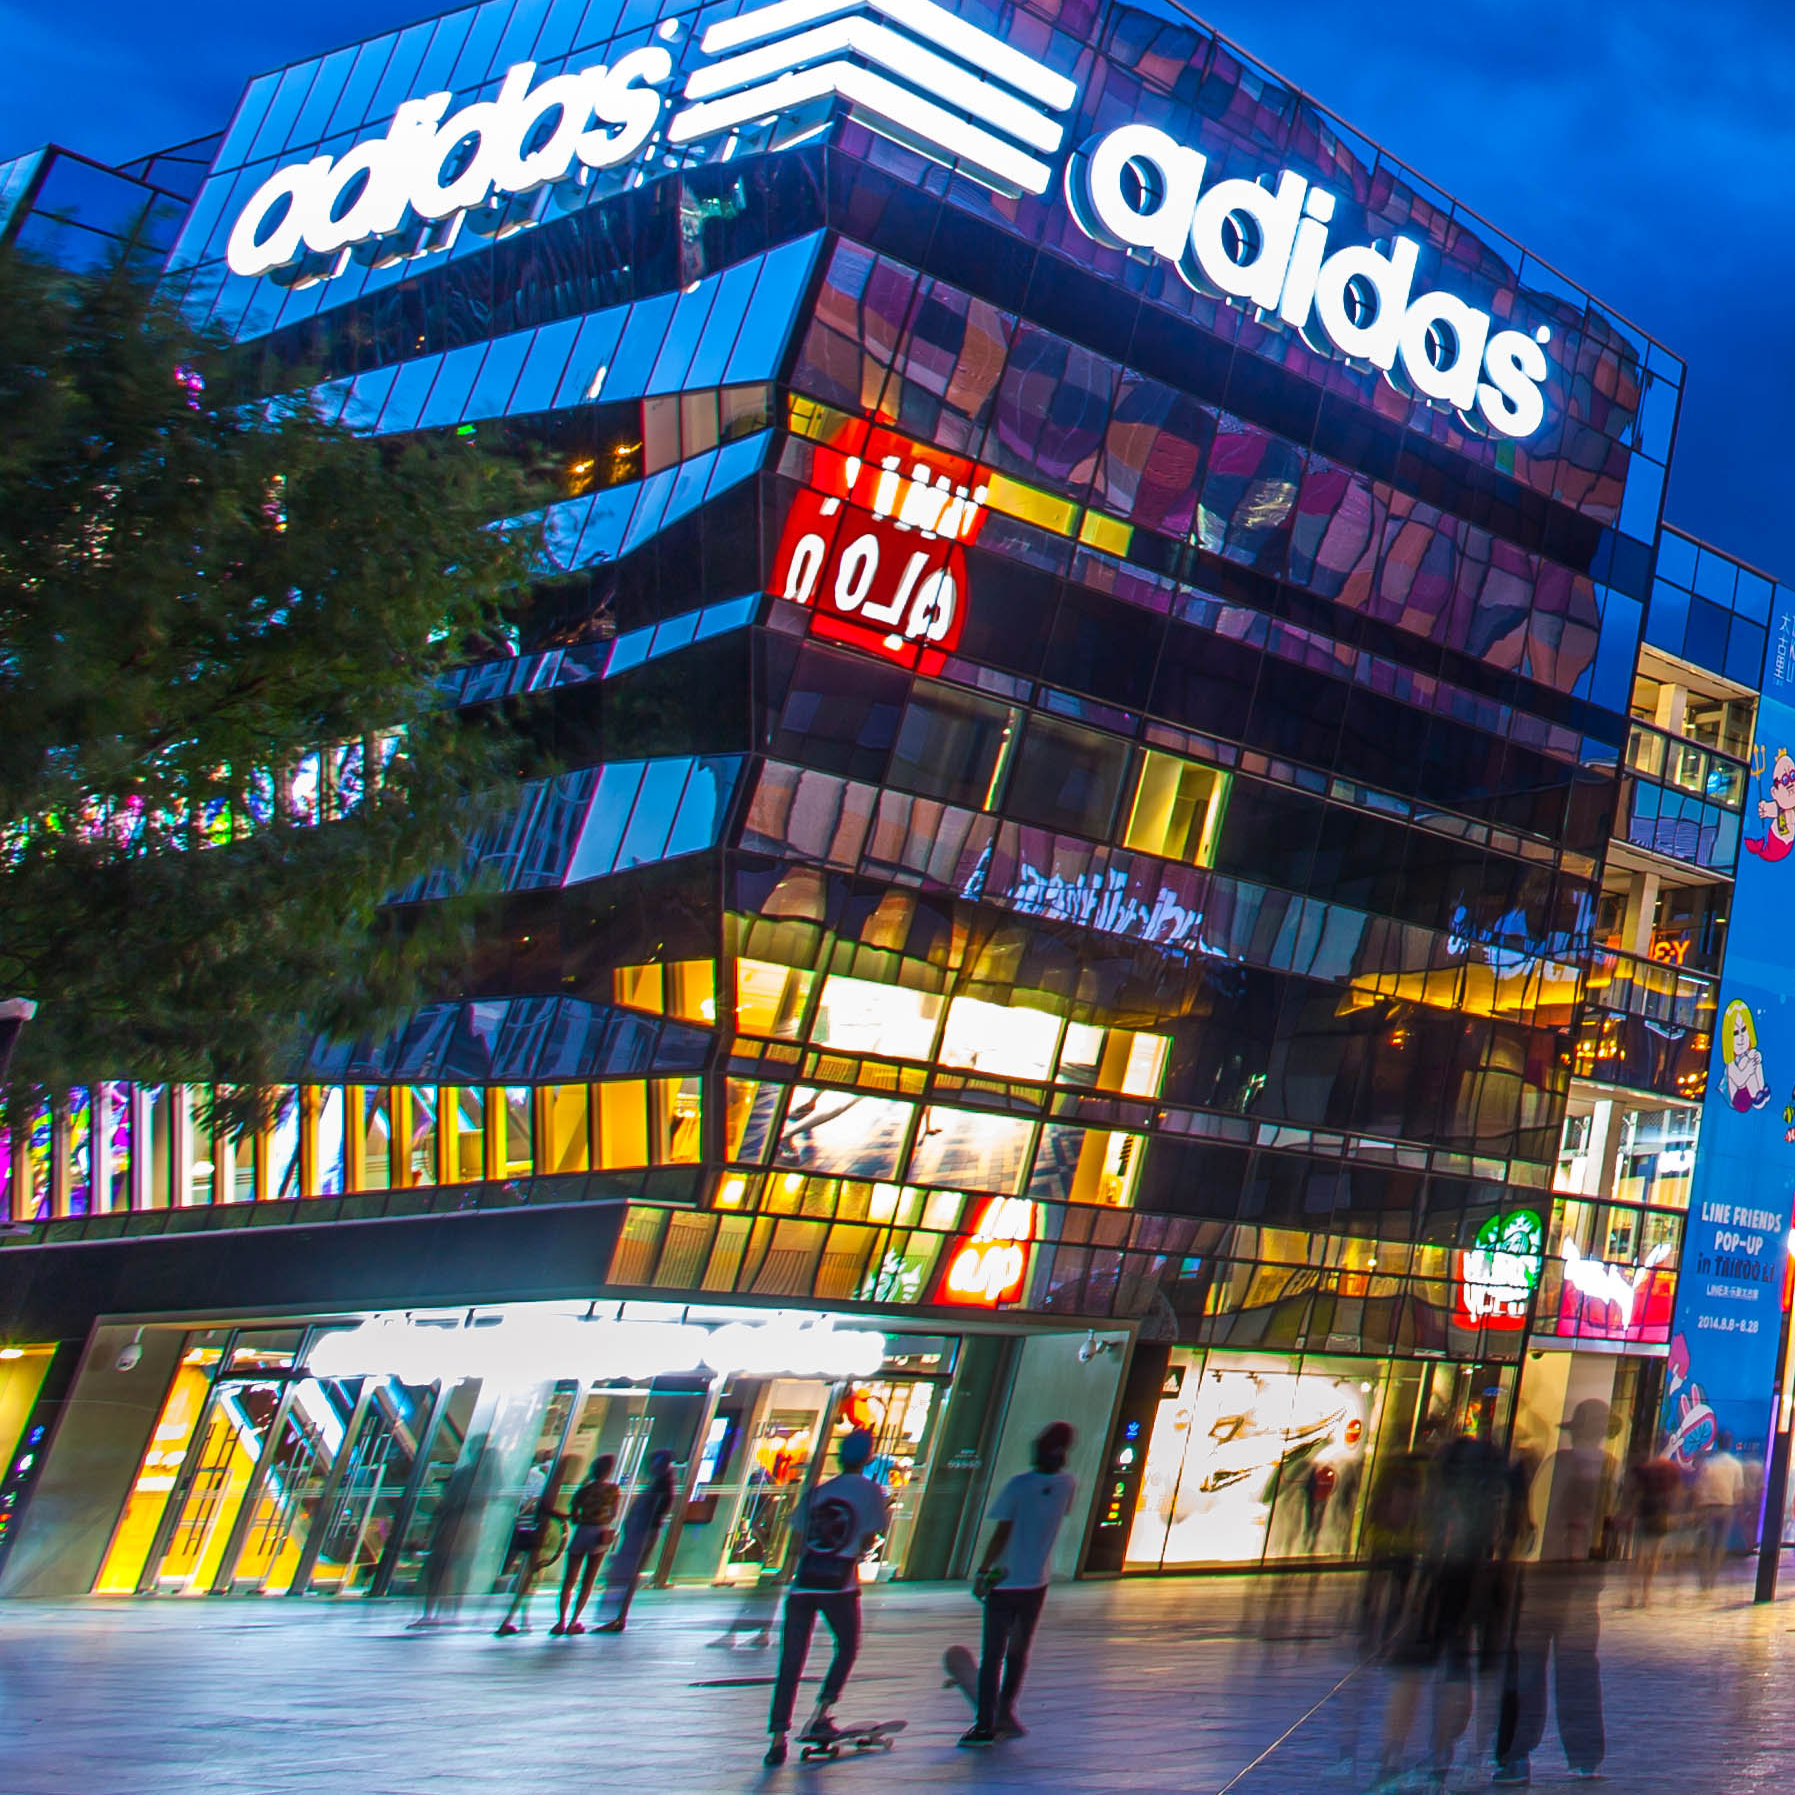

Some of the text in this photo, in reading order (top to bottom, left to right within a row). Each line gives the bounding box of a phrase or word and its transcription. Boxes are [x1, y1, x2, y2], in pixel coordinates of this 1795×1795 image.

[226, 46, 673, 277] adidas
[1085, 122, 1549, 438] adidas
[1701, 1201, 1783, 1233] LINE FRIENDS
[1714, 1230, 1763, 1256] POP-UP
[1697, 1253, 1711, 1274] in
